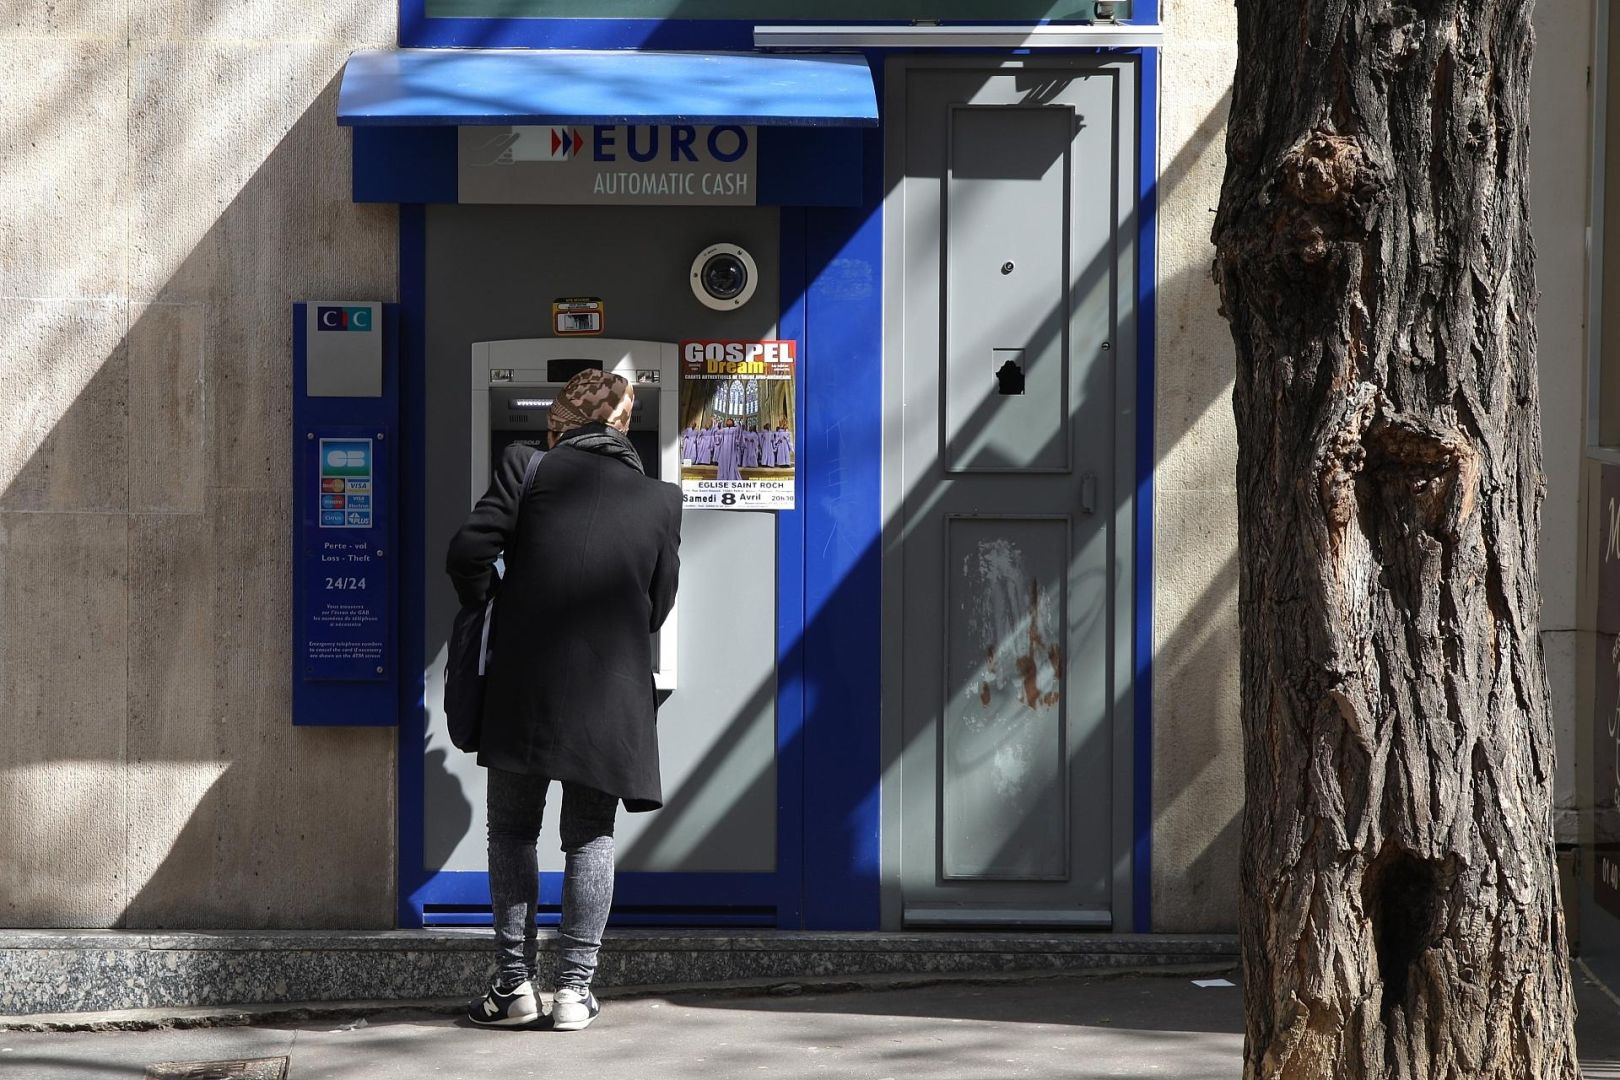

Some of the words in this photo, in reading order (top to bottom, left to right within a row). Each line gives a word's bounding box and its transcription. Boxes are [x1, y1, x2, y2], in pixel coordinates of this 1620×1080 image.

[593, 125, 748, 162] EURO
[593, 173, 694, 194] AUTOMATIC
[702, 173, 747, 194] CASH
[685, 343, 793, 362] GOSPEL
[707, 360, 763, 373] Dream
[683, 493, 717, 503] Samedi
[721, 493, 736, 505] 8
[740, 493, 761, 501] Avril
[324, 542, 347, 550] Perte
[354, 542, 367, 550] vol
[322, 554, 340, 562] Loss
[348, 554, 370, 562] Theft
[325, 577, 366, 590] 24/24
[483, 996, 500, 1017] N
